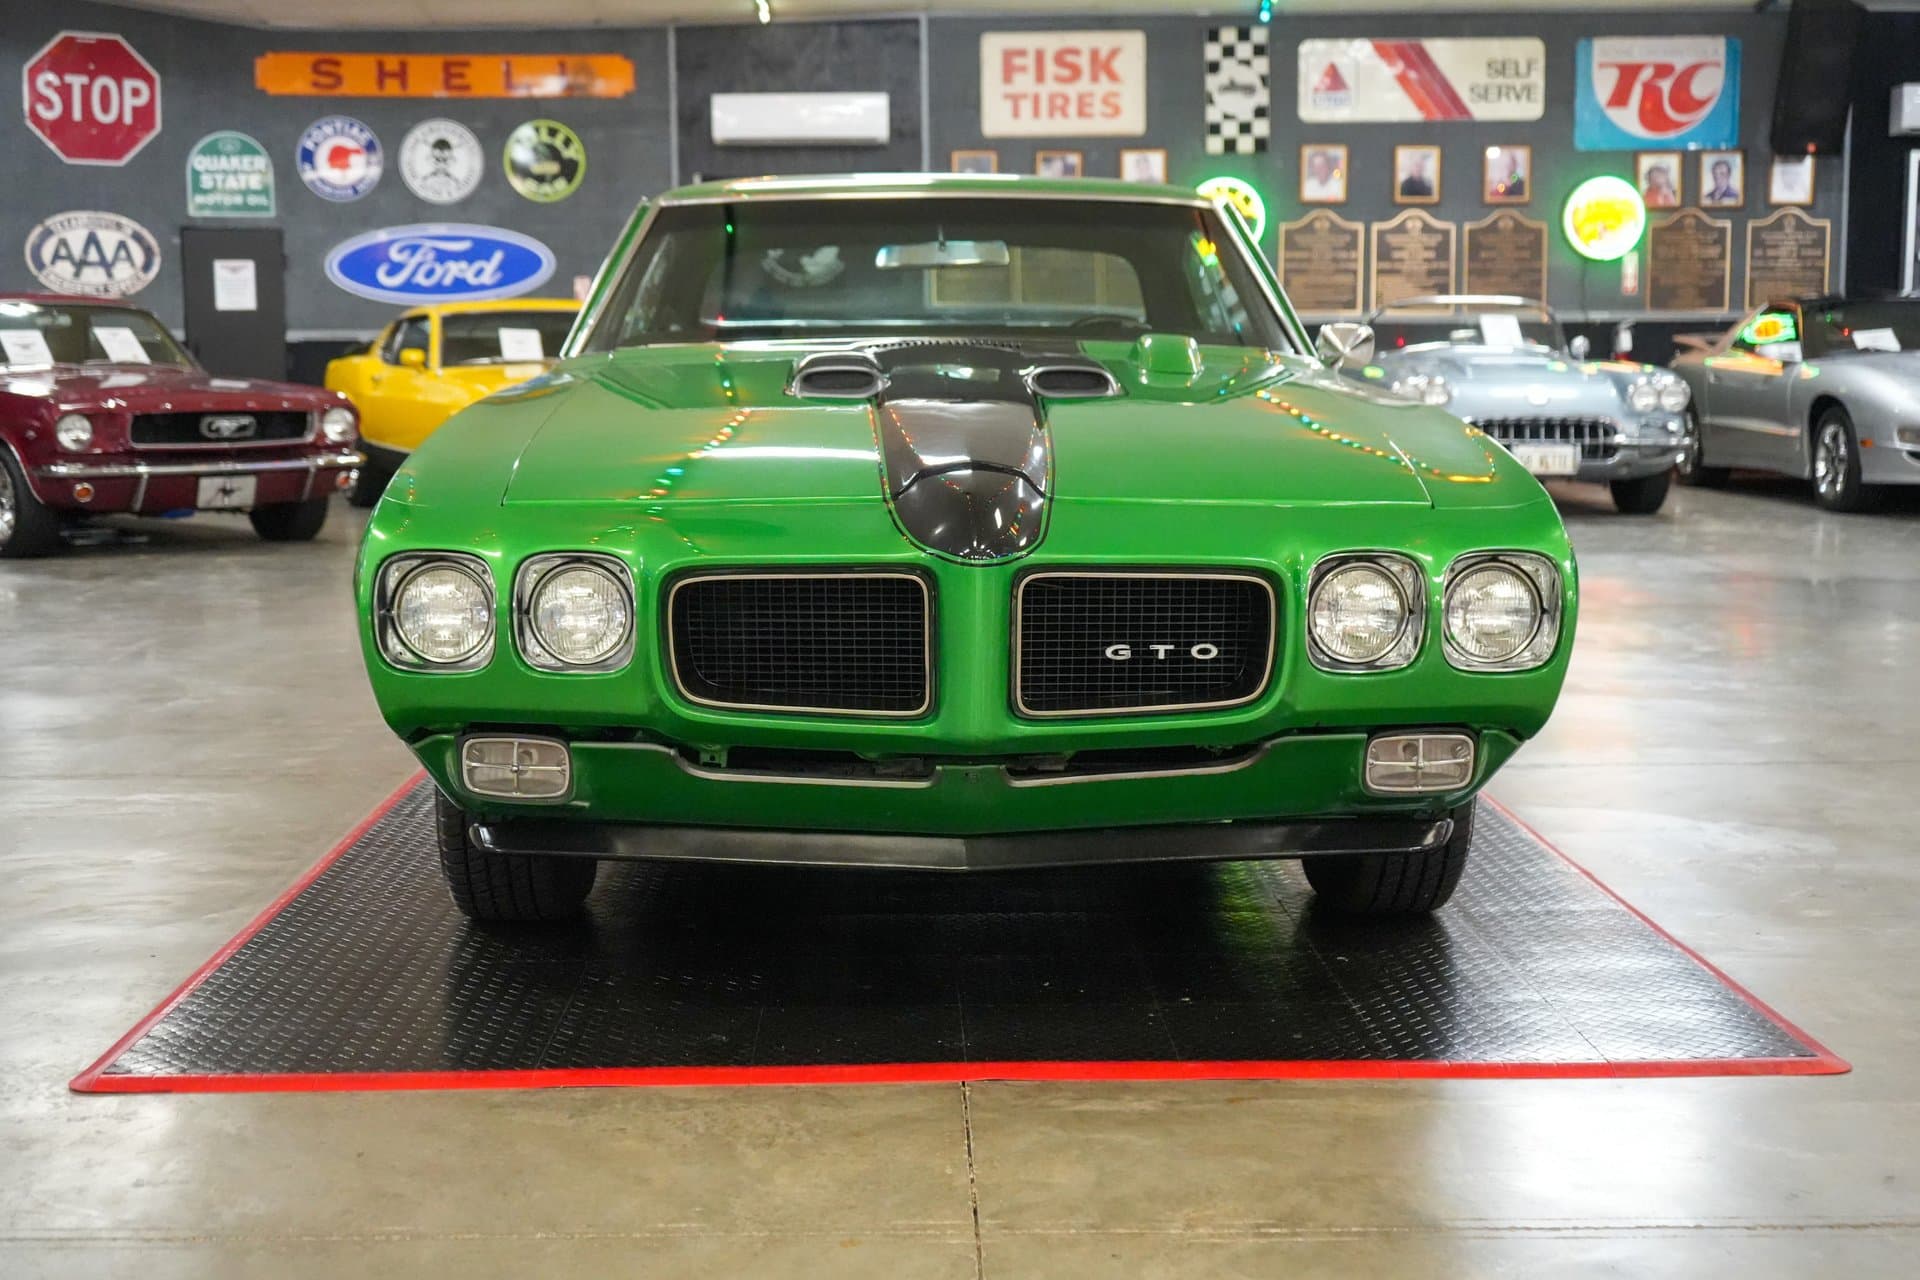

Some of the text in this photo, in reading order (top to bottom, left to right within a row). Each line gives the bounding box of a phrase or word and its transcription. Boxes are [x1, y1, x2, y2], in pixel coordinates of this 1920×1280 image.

[1001, 47, 1124, 84] FISK
[1486, 58, 1538, 79] SELF
[35, 71, 150, 125] STOP
[1003, 92, 1122, 119] TIRES
[1469, 83, 1537, 105] SERVE
[1597, 62, 1721, 133] RC
[193, 154, 266, 172] QUAKER
[199, 173, 263, 190] STATE
[50, 230, 137, 278] AAA
[376, 238, 505, 287] Ford
[1105, 643, 1218, 660] GTO
